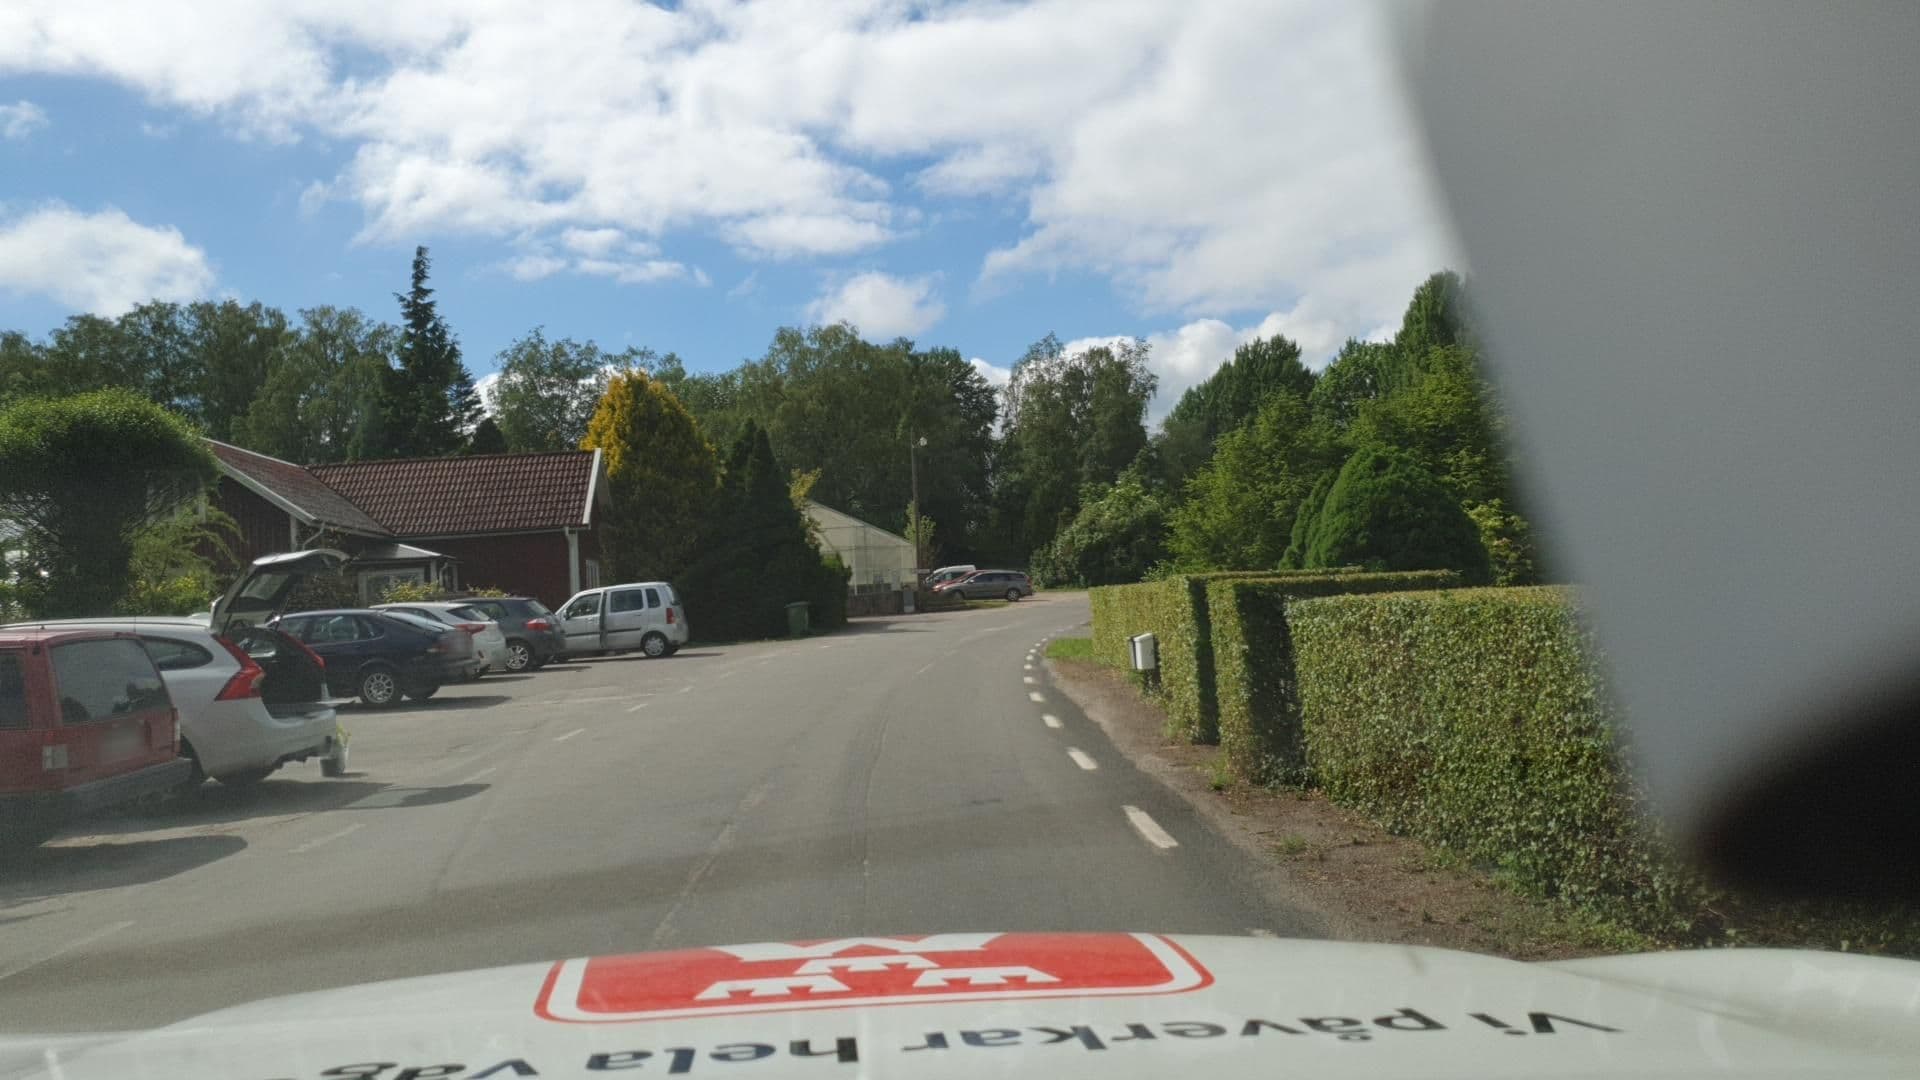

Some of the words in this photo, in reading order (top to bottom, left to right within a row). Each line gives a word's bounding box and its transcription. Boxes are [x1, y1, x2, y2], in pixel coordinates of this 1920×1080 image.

[902, 1007, 1448, 1051] påverkar
[1467, 1011, 1623, 1036] Vi
[585, 1037, 859, 1075] hela
